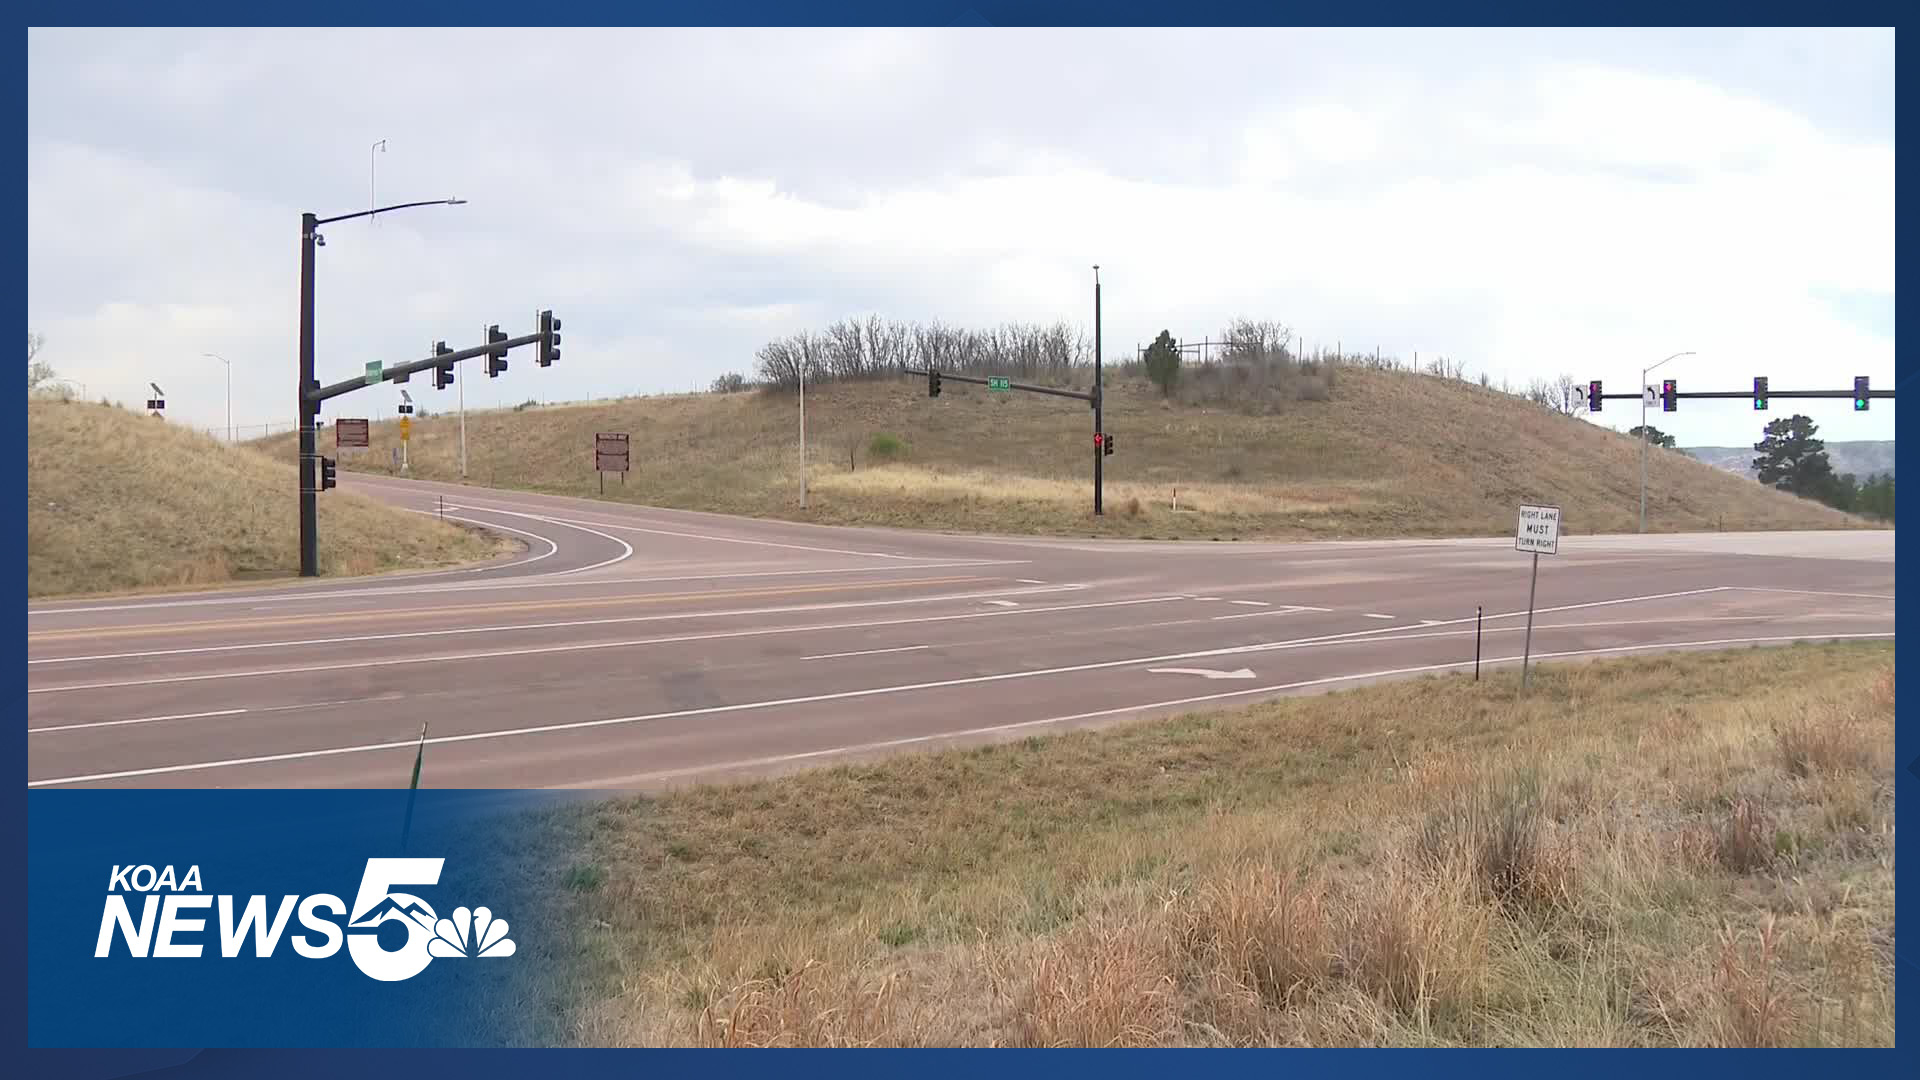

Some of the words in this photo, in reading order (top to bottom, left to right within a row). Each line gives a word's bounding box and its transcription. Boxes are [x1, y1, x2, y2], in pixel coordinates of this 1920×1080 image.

[1521, 510, 1539, 519] RIGHT
[1540, 511, 1557, 521] LANE
[1526, 524, 1549, 535] MUST
[1519, 537, 1535, 546] TURN
[1536, 540, 1555, 548] RIGHT
